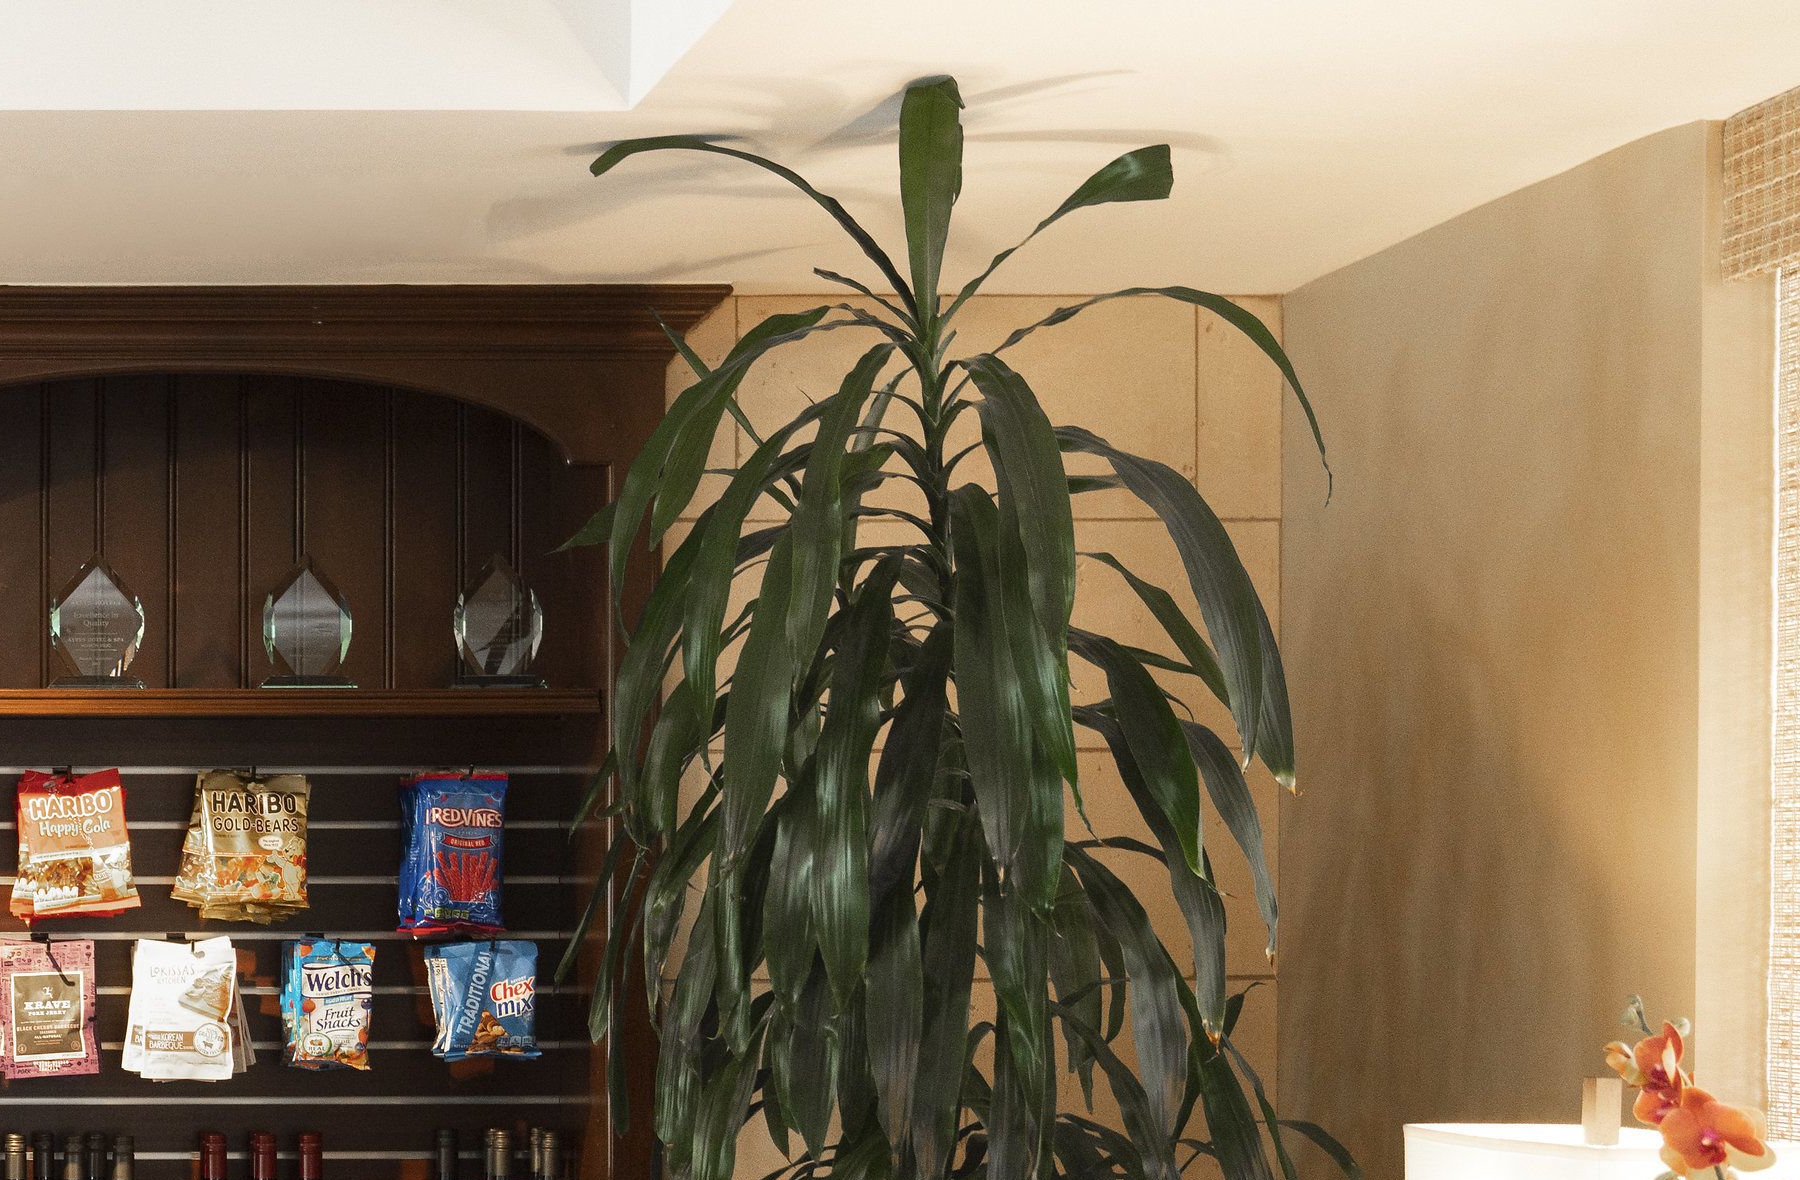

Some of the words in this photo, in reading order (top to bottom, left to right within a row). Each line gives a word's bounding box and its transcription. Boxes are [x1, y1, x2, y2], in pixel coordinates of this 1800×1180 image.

[29, 789, 112, 820] HARIBO
[212, 790, 297, 815] HARIBO
[39, 821, 79, 838] Happy
[82, 815, 110, 834] Cola
[213, 817, 298, 832] GOLD-BEARS
[304, 968, 372, 992] Welch's
[490, 976, 536, 1002] Chex
[456, 951, 491, 1035] TRADITIONAL
[24, 1000, 70, 1010] KRAVE
[324, 1006, 356, 1020] Fruit
[496, 994, 534, 1018] mix
[316, 1018, 361, 1032] Snacks
[160, 1032, 184, 1042] KOREAN
